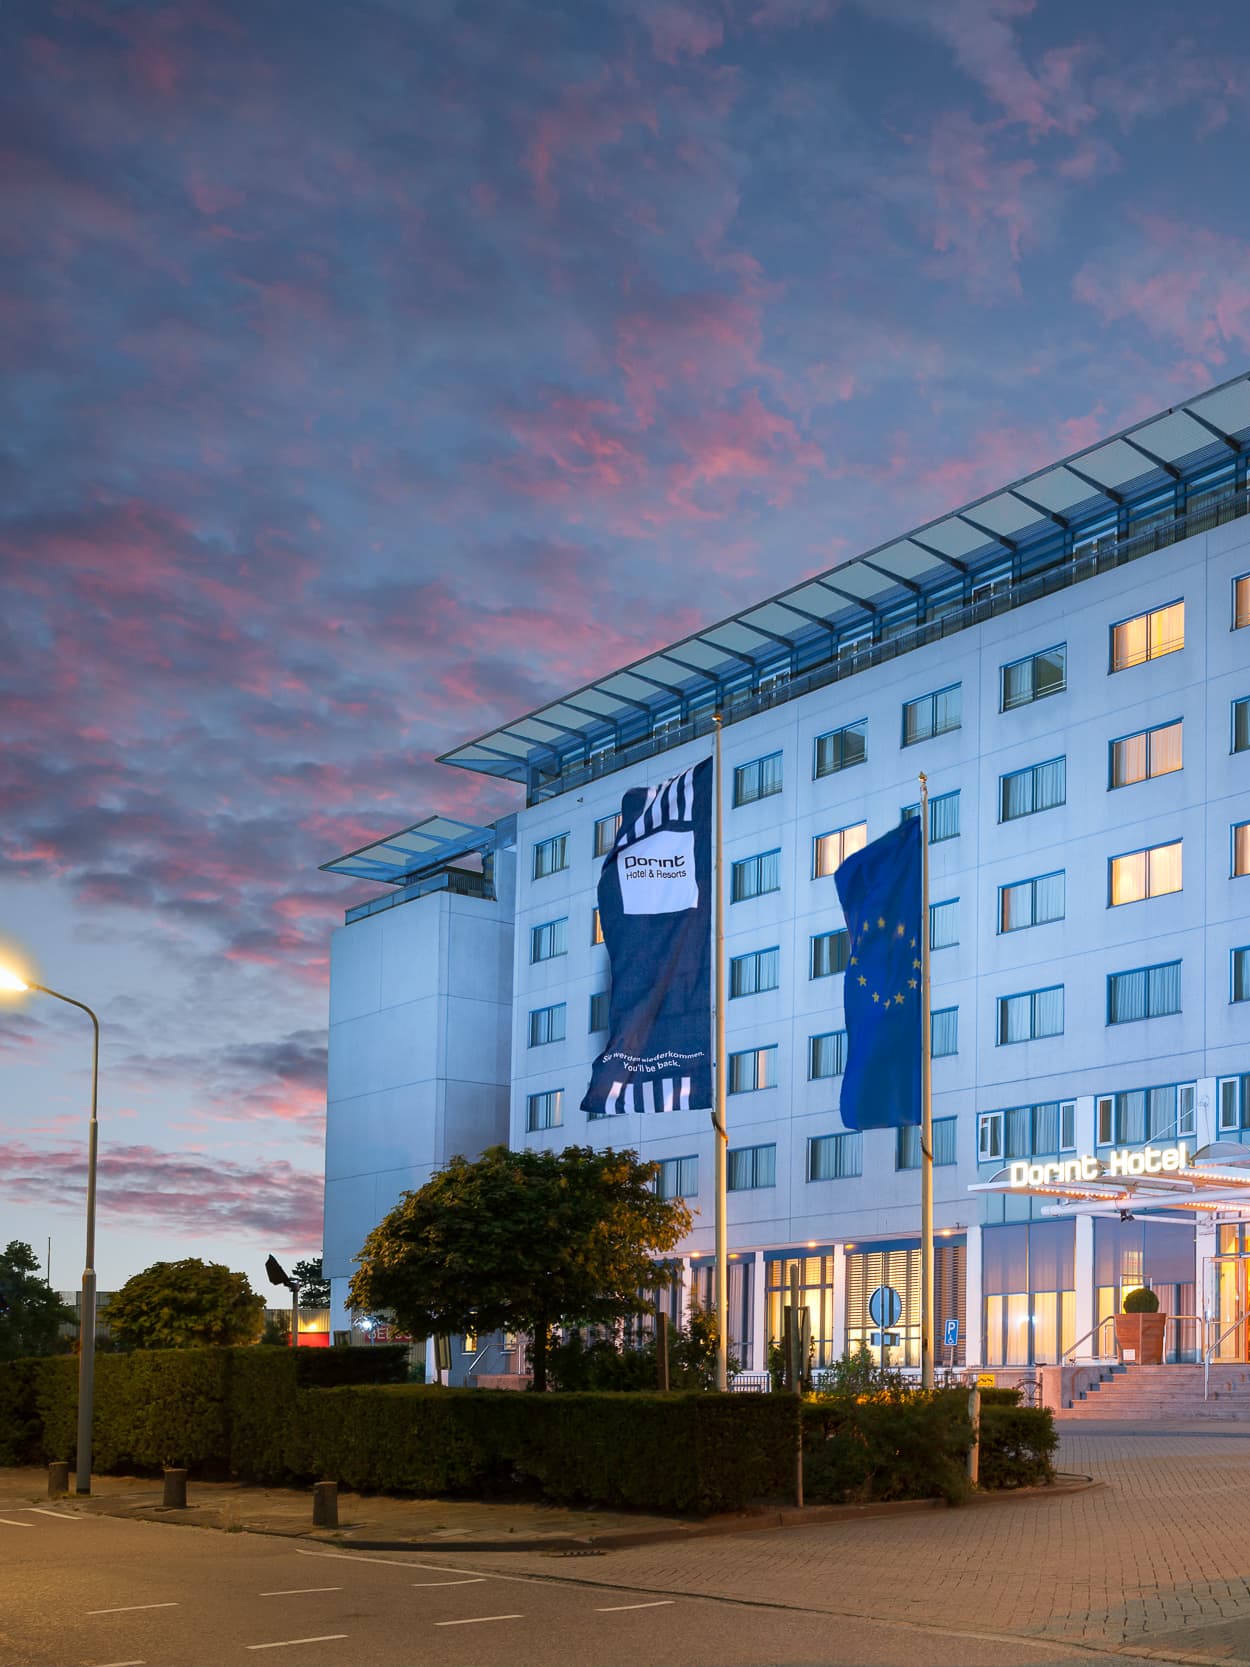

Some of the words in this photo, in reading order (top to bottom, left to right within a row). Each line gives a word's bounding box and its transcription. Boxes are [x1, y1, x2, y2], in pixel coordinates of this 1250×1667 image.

[624, 855, 685, 869] Dorint
[626, 869, 647, 880] Hotel
[648, 869, 655, 878] &
[656, 870, 687, 879] Resorts
[613, 1052, 641, 1062] werden
[623, 1061, 645, 1072] You'll
[645, 1065, 656, 1073] be
[657, 1059, 681, 1071] back.
[1009, 1154, 1099, 1188] Dorint
[1109, 1142, 1188, 1177] Hotel
[948, 1321, 956, 1335] P
